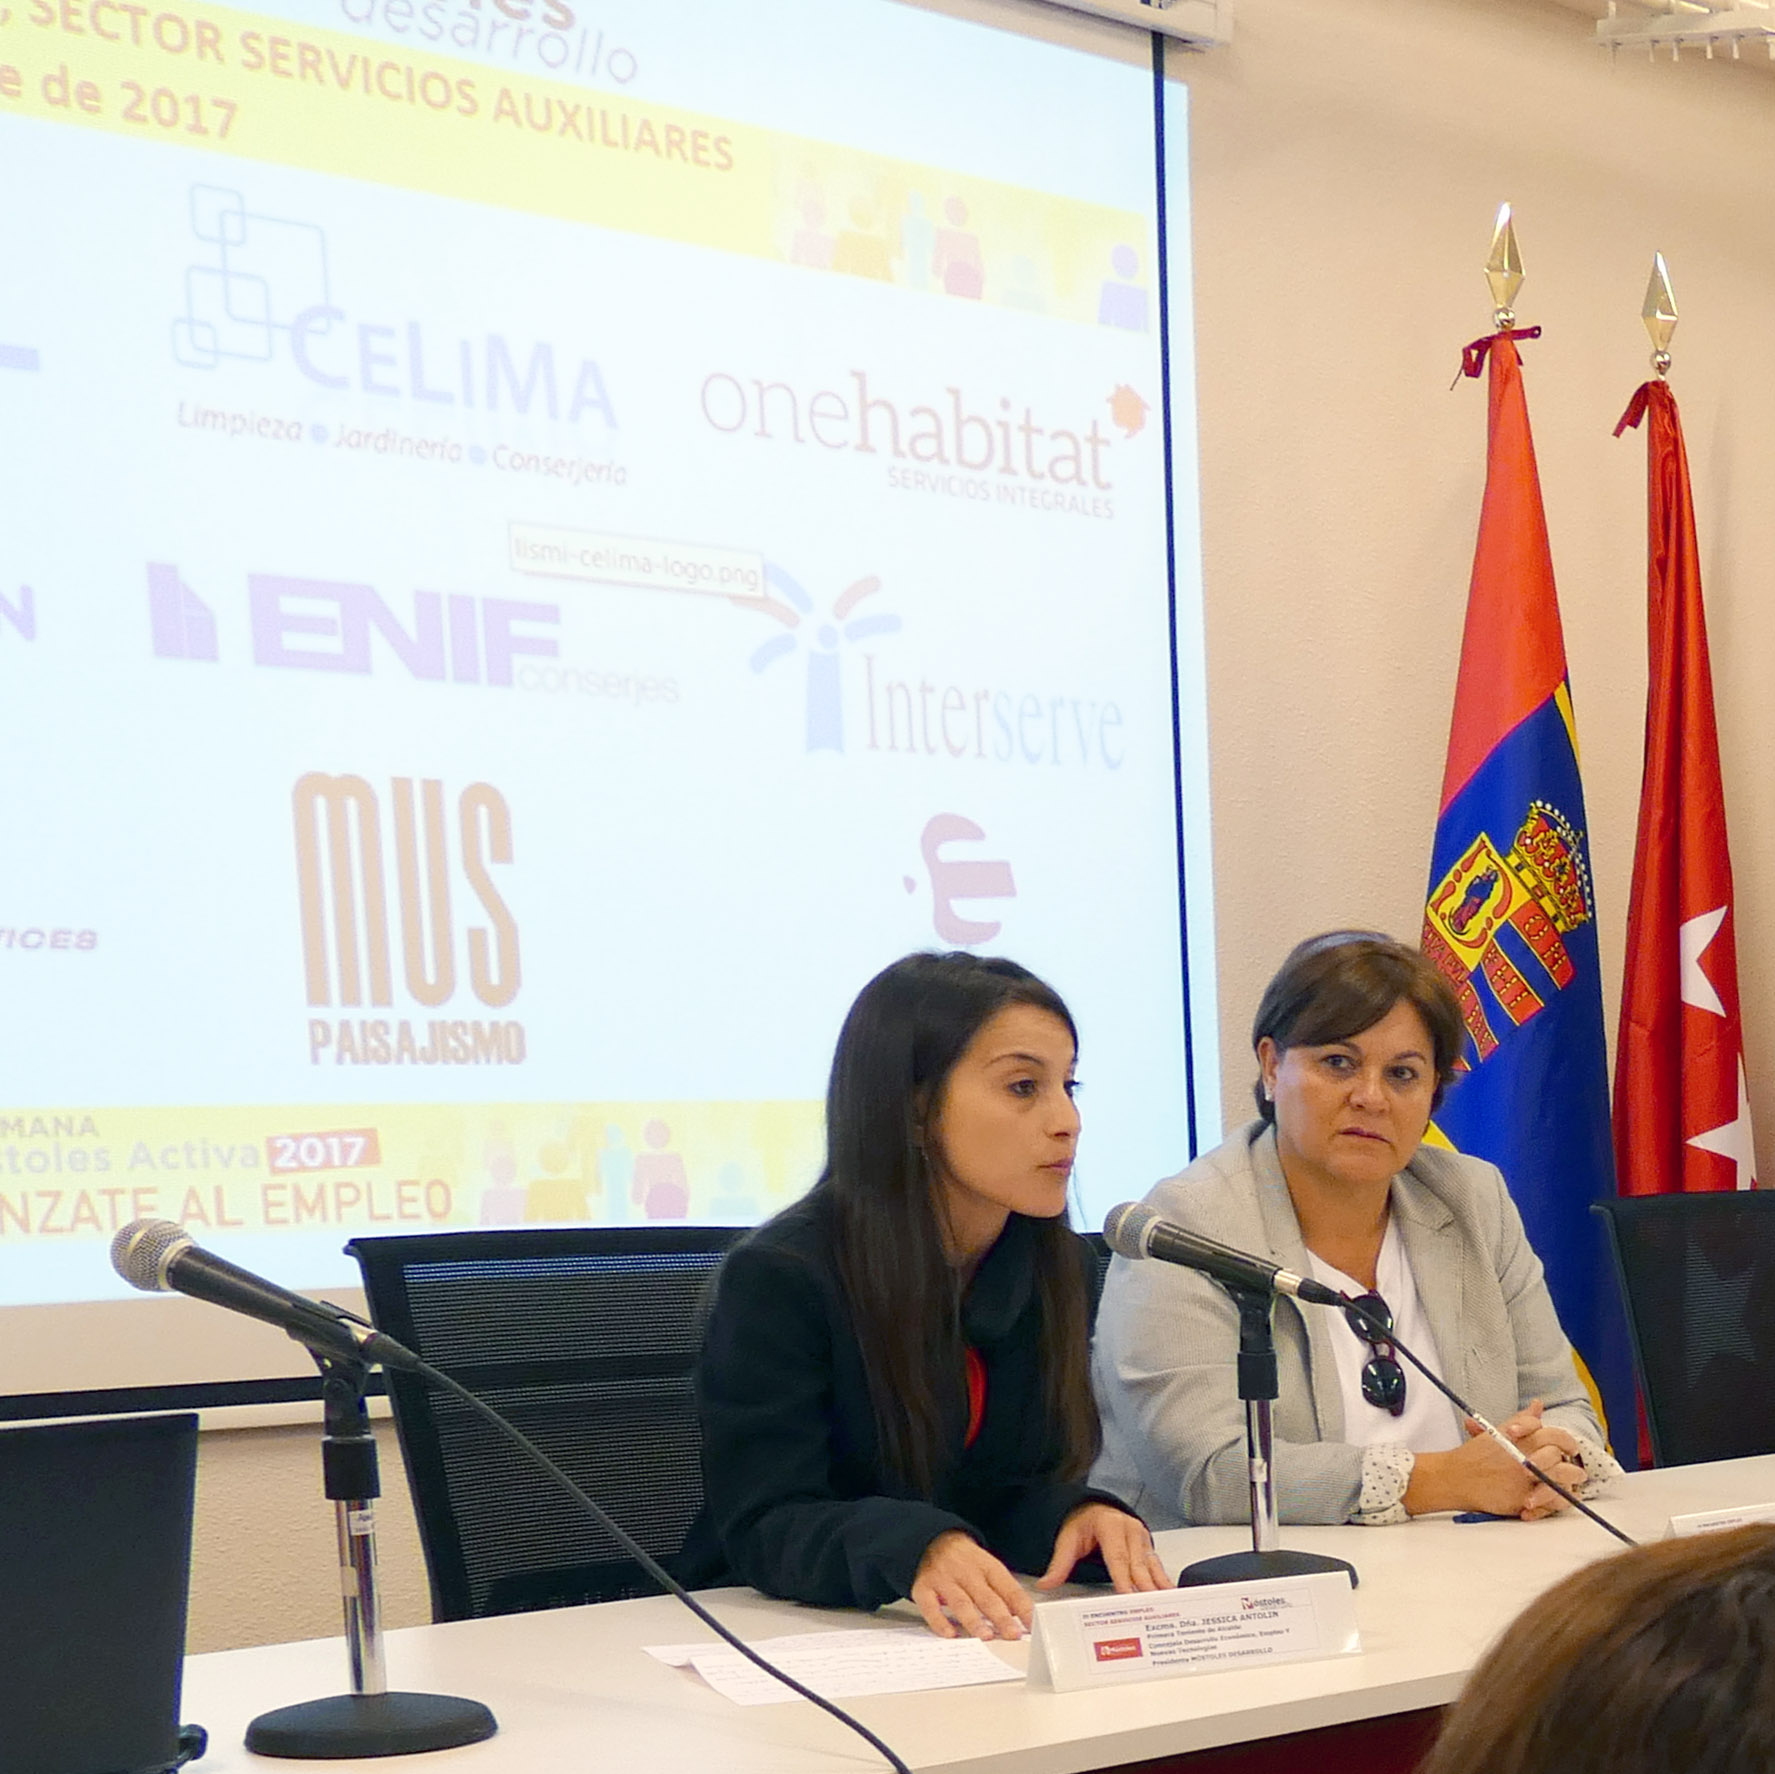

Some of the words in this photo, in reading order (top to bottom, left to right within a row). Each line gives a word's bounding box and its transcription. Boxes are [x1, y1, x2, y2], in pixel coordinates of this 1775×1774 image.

[28, 0, 227, 66] SECTOR
[238, 29, 480, 118] SERVICIOS
[492, 85, 735, 173] AUXILIARES
[40, 61, 105, 117] de
[119, 79, 241, 142] 2017
[290, 303, 621, 431] CELIMA
[176, 400, 304, 442] Limpieza
[701, 368, 1115, 492] onehabitat
[887, 464, 991, 503] SERVICIOS
[995, 482, 1116, 521] INTEGRALES
[246, 571, 562, 690] ENIF
[517, 663, 683, 708] conserjes
[862, 651, 1127, 772] Interserve
[290, 770, 523, 1010] MUS
[0, 926, 99, 951] ICES
[307, 1016, 529, 1067] PAISAJISMO
[0, 1141, 112, 1175] toles
[126, 1138, 261, 1172] Activa
[273, 1135, 368, 1169] 2017
[179, 1183, 245, 1230] AL
[259, 1177, 455, 1227] EMPLEO
[1201, 1615, 1239, 1626] JESSICA
